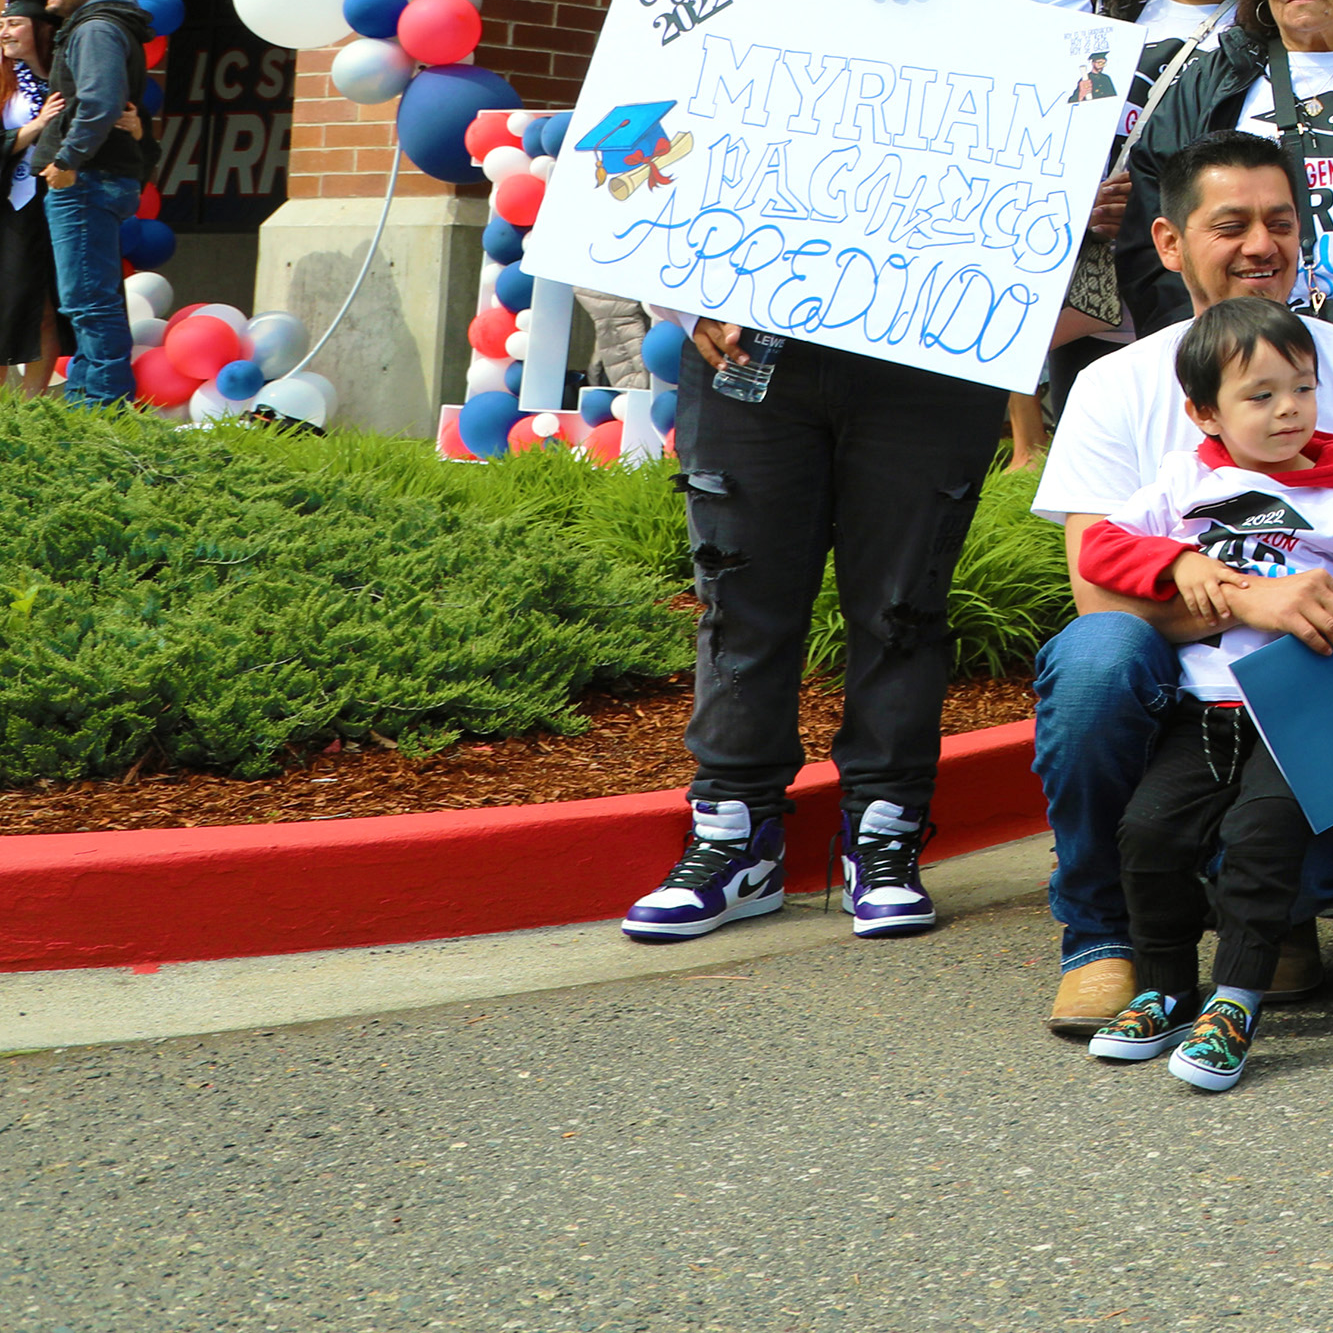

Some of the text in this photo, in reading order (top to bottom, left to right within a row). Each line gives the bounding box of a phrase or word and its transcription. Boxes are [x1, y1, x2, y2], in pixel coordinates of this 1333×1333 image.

[688, 34, 1079, 177] MYRIAM
[701, 134, 1073, 273] PACHECO
[589, 187, 1039, 364] ARREDONDO
[1242, 509, 1286, 526] 2022
